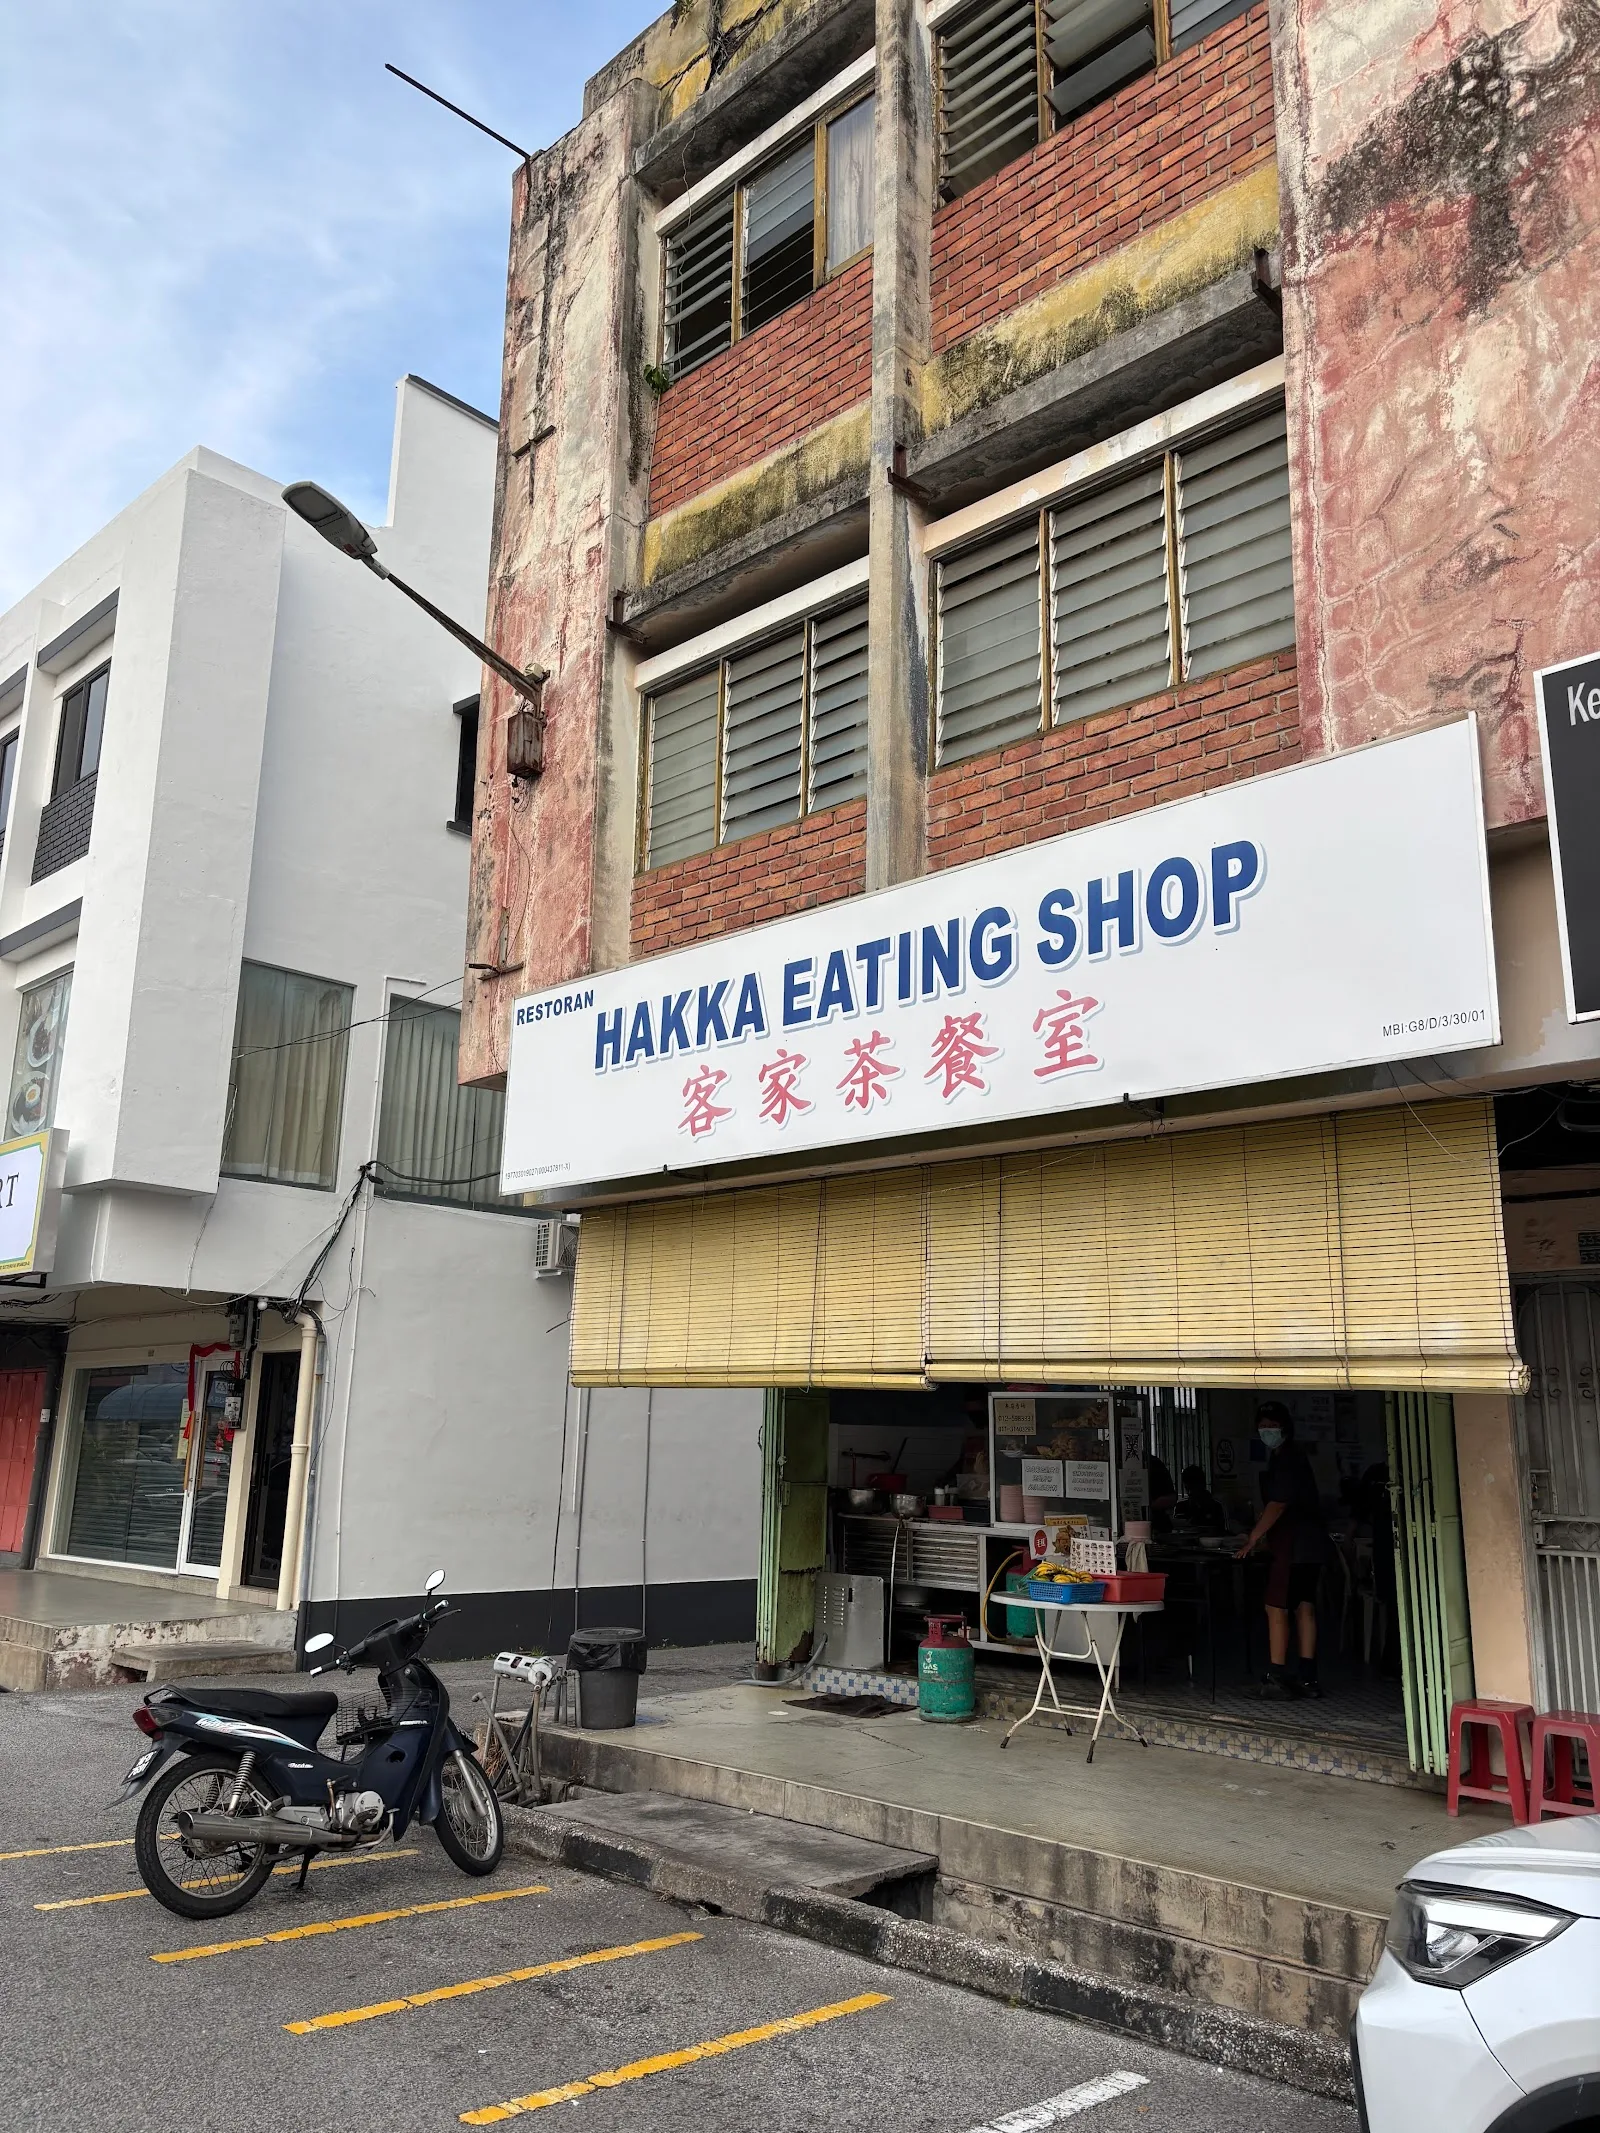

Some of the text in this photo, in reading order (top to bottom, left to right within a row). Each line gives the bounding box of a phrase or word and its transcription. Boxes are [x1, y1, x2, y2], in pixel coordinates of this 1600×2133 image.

[595, 841, 1259, 1068] HAKKA EATING SHOP
[517, 990, 594, 1026] RESTORAN
[1382, 1009, 1486, 1037] MBI:G8/D/3/30/01
[679, 988, 1099, 1136] 客家茶餐室
